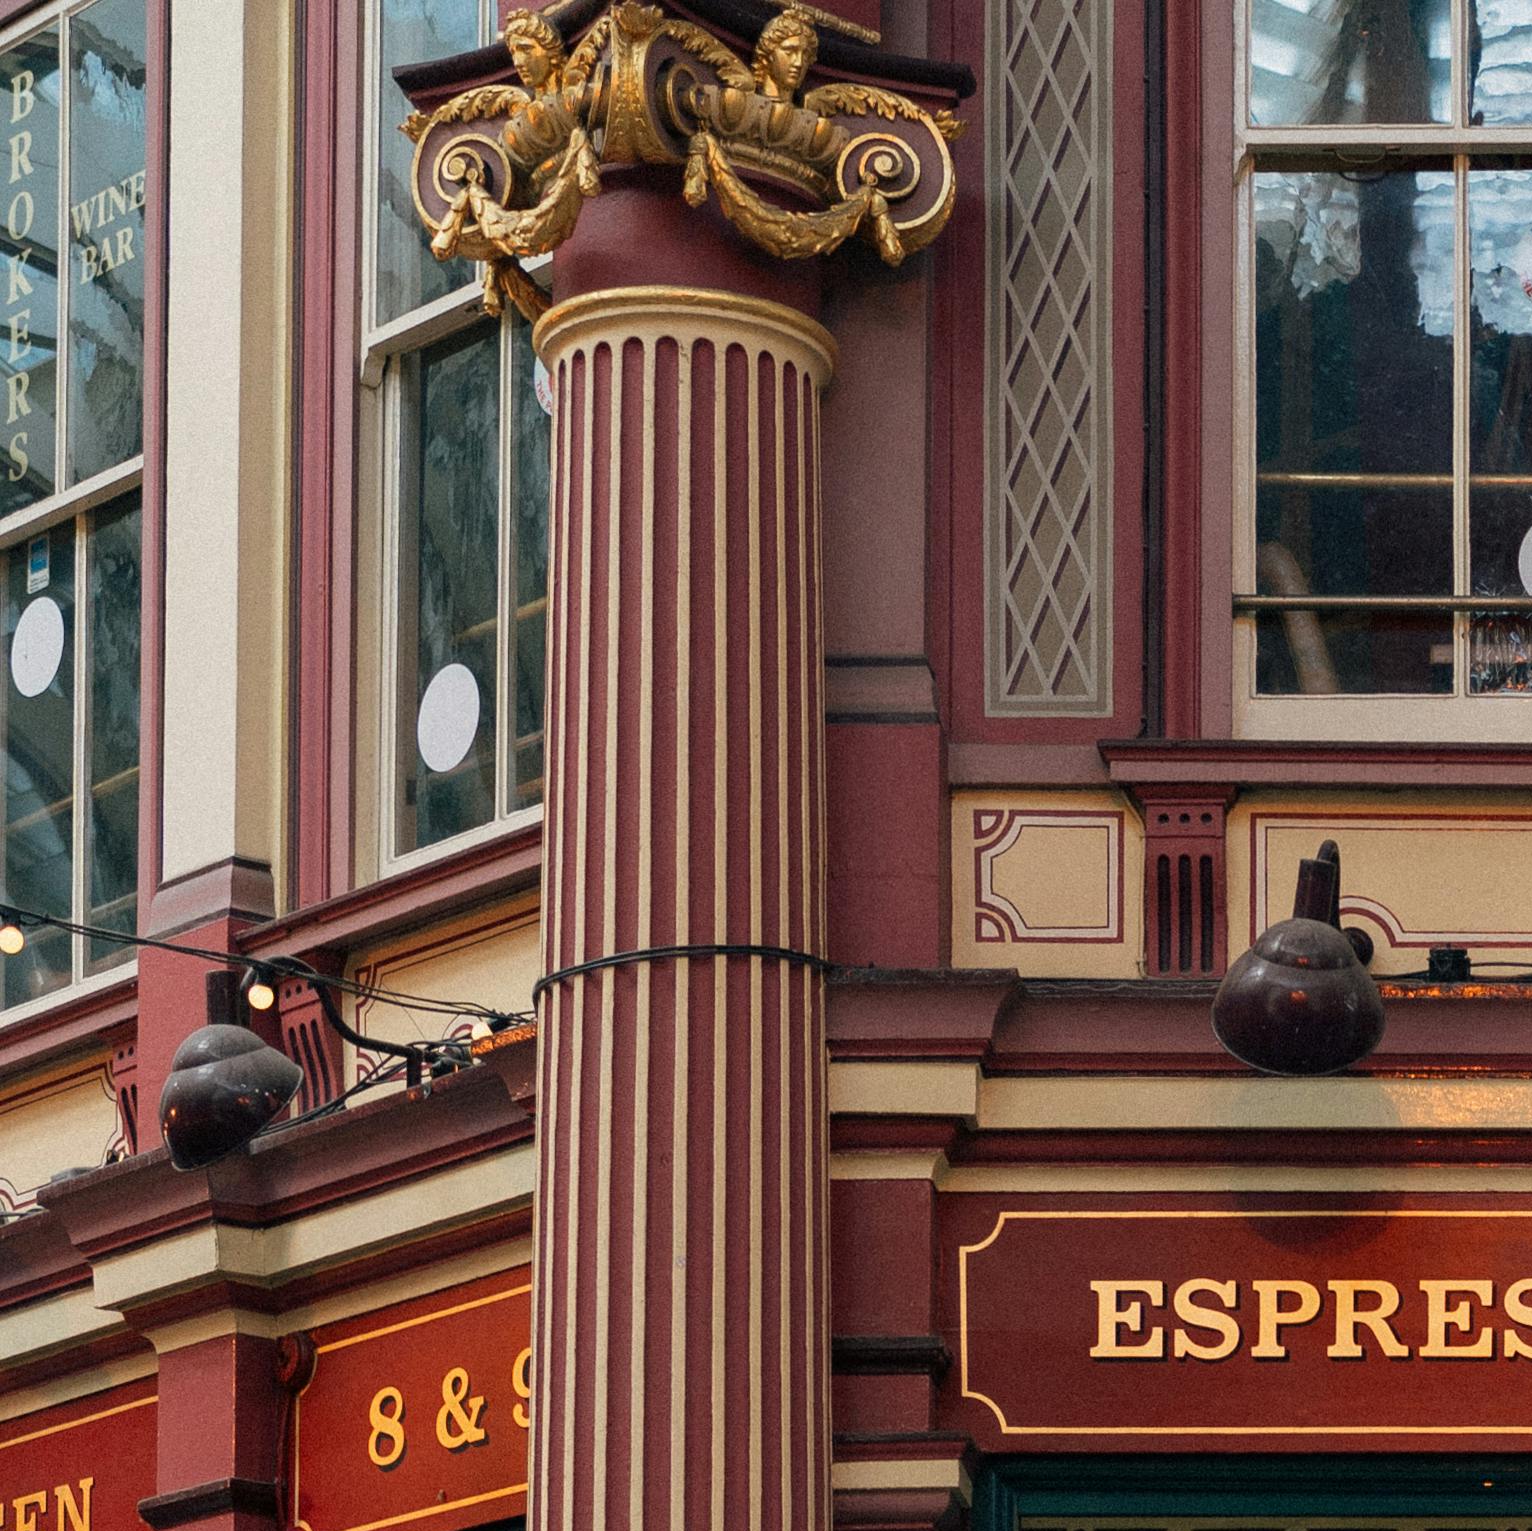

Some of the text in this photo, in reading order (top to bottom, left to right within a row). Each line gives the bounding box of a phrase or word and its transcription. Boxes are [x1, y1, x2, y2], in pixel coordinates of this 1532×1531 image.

[70, 168, 146, 240] WINE
[7, 70, 35, 483] BROKERS
[80, 226, 135, 285] BAR
[368, 1385, 406, 1468] 8
[435, 1366, 488, 1450] &
